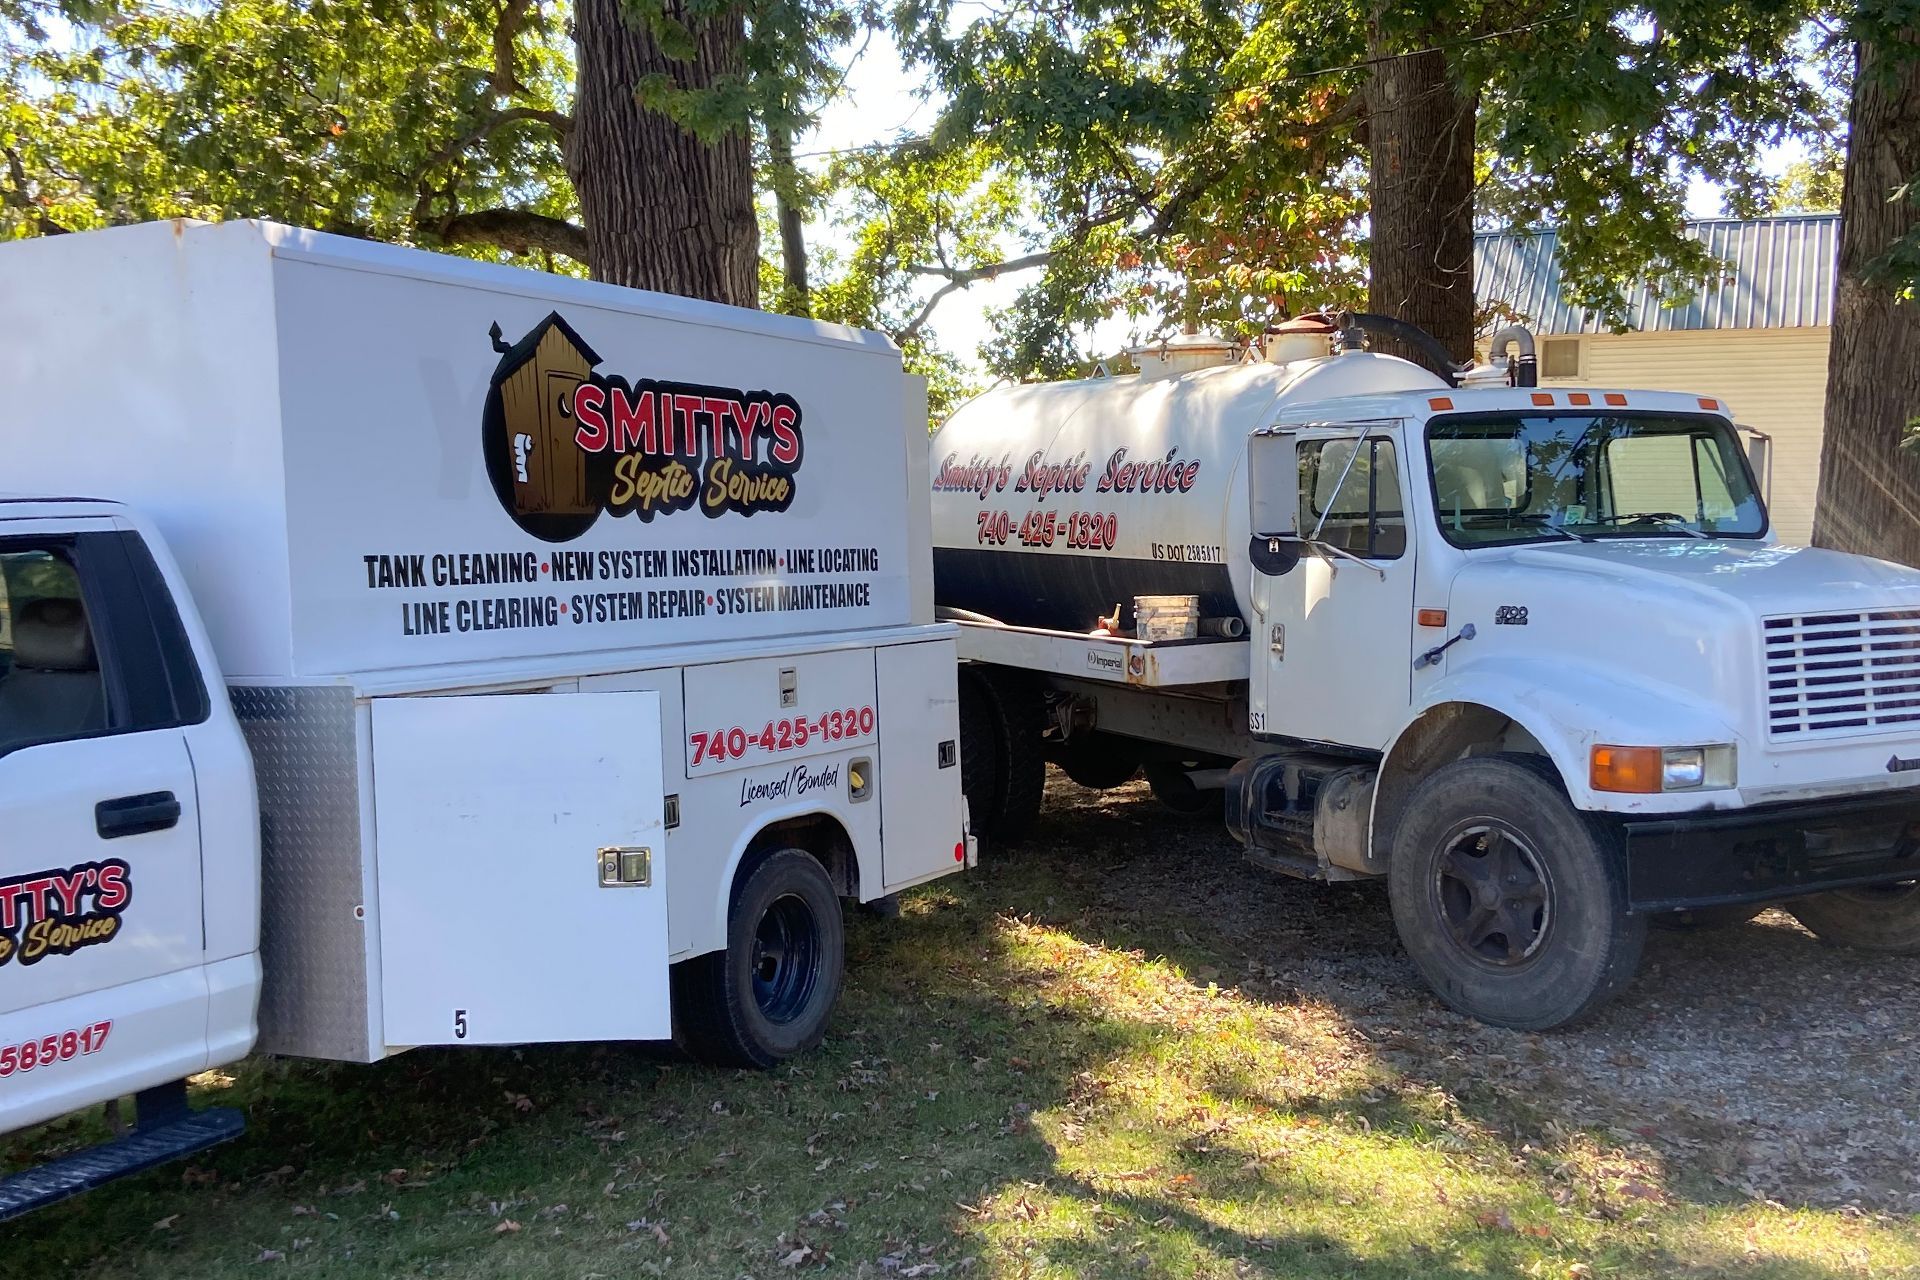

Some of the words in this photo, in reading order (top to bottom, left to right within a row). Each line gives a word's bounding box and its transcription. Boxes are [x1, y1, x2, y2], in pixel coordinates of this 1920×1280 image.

[574, 383, 799, 464] SMITTY'S
[611, 452, 694, 510] Septic
[706, 457, 790, 507] Service
[932, 450, 1012, 501] Smitty's
[1015, 447, 1093, 502] Septic
[1096, 445, 1201, 494] Service
[977, 510, 1119, 550] 740-425-1320
[1151, 542, 1164, 559] US
[1167, 544, 1185, 561] DOT
[1187, 544, 1220, 562] 2585817
[363, 554, 427, 588] TANK
[432, 552, 538, 586] CLEANING
[552, 551, 594, 582] NEW
[598, 550, 668, 580] SYSTEM
[672, 549, 777, 577] INSTALLATION
[786, 548, 815, 574] LINE
[818, 547, 879, 573] LOCATING
[402, 602, 451, 635] LINE
[456, 596, 558, 632] CLEARING
[571, 591, 643, 625] SYSTEM
[647, 589, 706, 619] REPAIR
[716, 587, 775, 615] SYSTEM
[778, 583, 870, 612] MAINTENANCE
[690, 704, 875, 767] 740-425-1320
[740, 763, 840, 807] Licensed/Bonded
[24, 915, 117, 958] Service
[455, 1009, 467, 1039] 5
